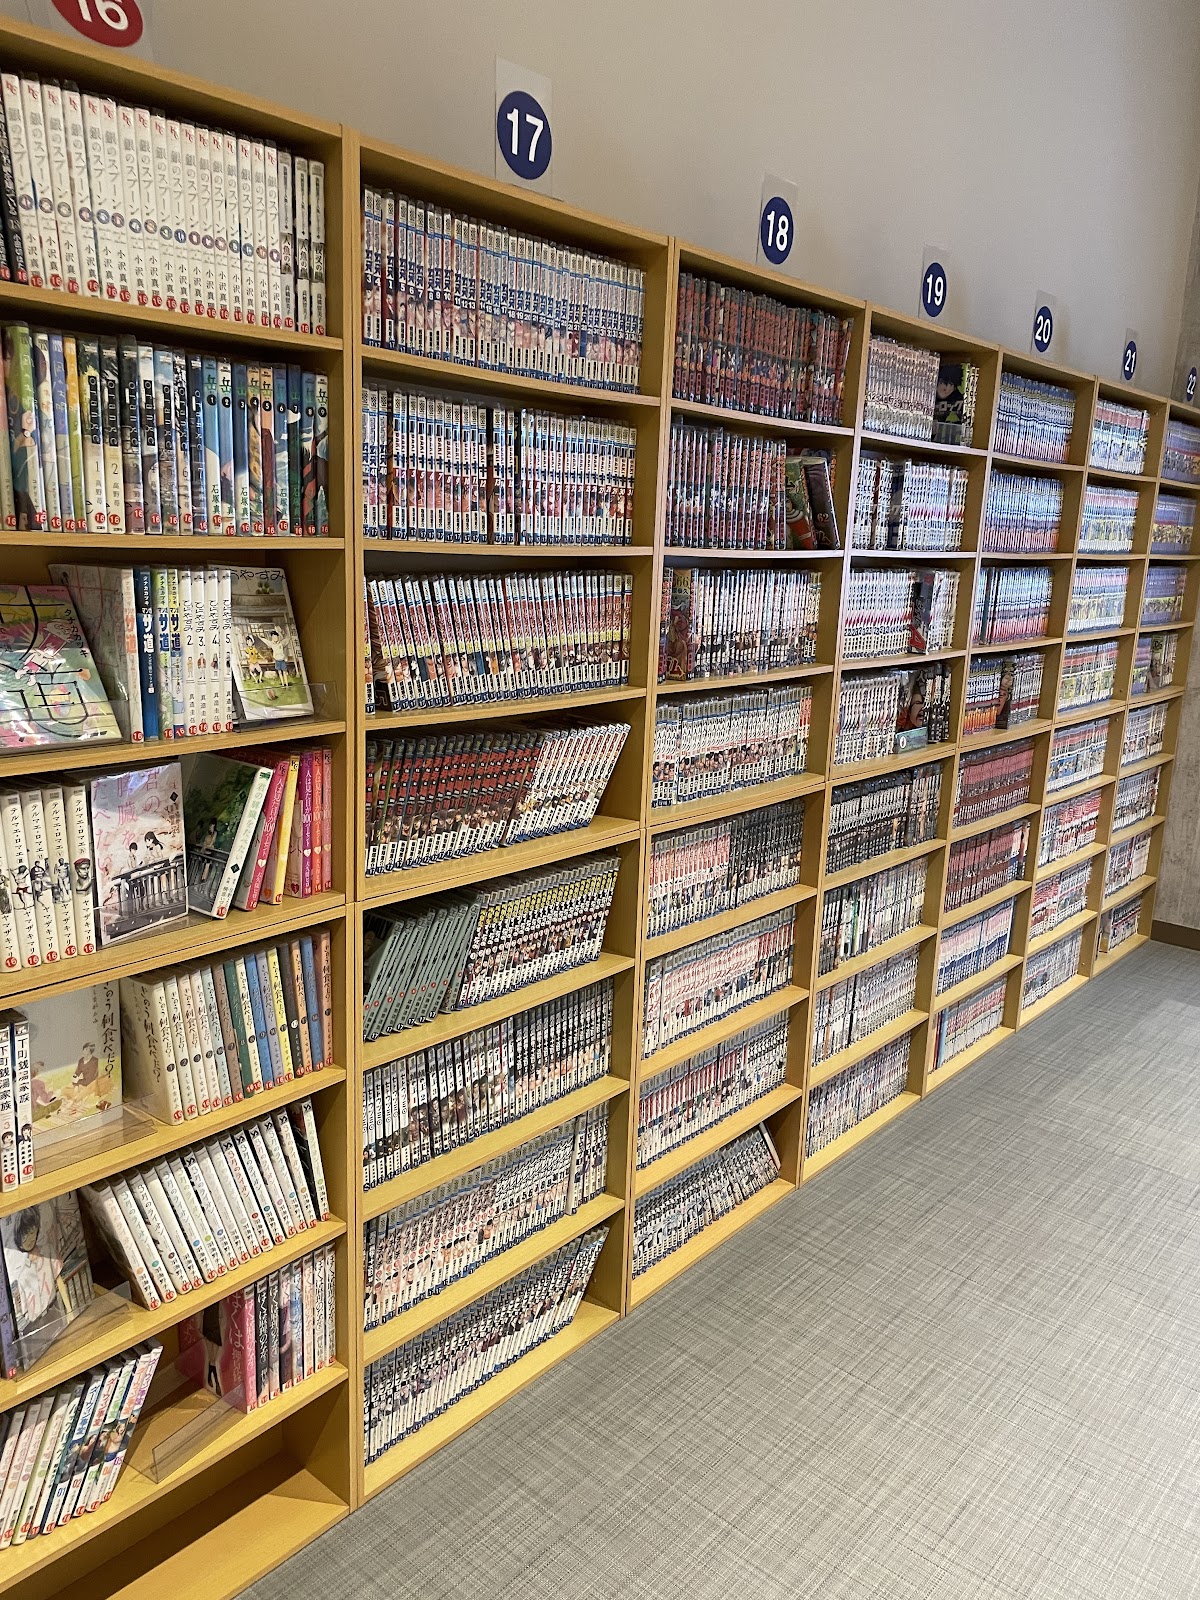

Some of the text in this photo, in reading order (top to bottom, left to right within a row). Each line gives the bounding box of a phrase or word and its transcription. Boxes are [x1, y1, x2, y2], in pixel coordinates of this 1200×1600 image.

[79, 0, 128, 30] 16
[506, 108, 544, 163] 17
[766, 210, 789, 252] 18
[926, 273, 944, 306] 19
[1035, 314, 1050, 344] 20
[1125, 349, 1136, 373] 21
[1186, 374, 1196, 395] 22
[88, 376, 102, 444] orange
[108, 379, 119, 446] orange
[128, 382, 139, 447] orange
[144, 380, 155, 445] orange
[163, 386, 172, 450] orange
[178, 387, 188, 451] orange
[95, 461, 99, 472] 1
[111, 463, 119, 475] 2
[817, 513, 830, 523] 62
[64, 608, 89, 658] タナカカツキ
[142, 613, 155, 654] サ道
[158, 613, 170, 652] サ道
[170, 613, 181, 652] サ道
[114, 1456, 123, 1466] 05
[57, 1487, 65, 1498] 01
[73, 1478, 81, 1489] 02
